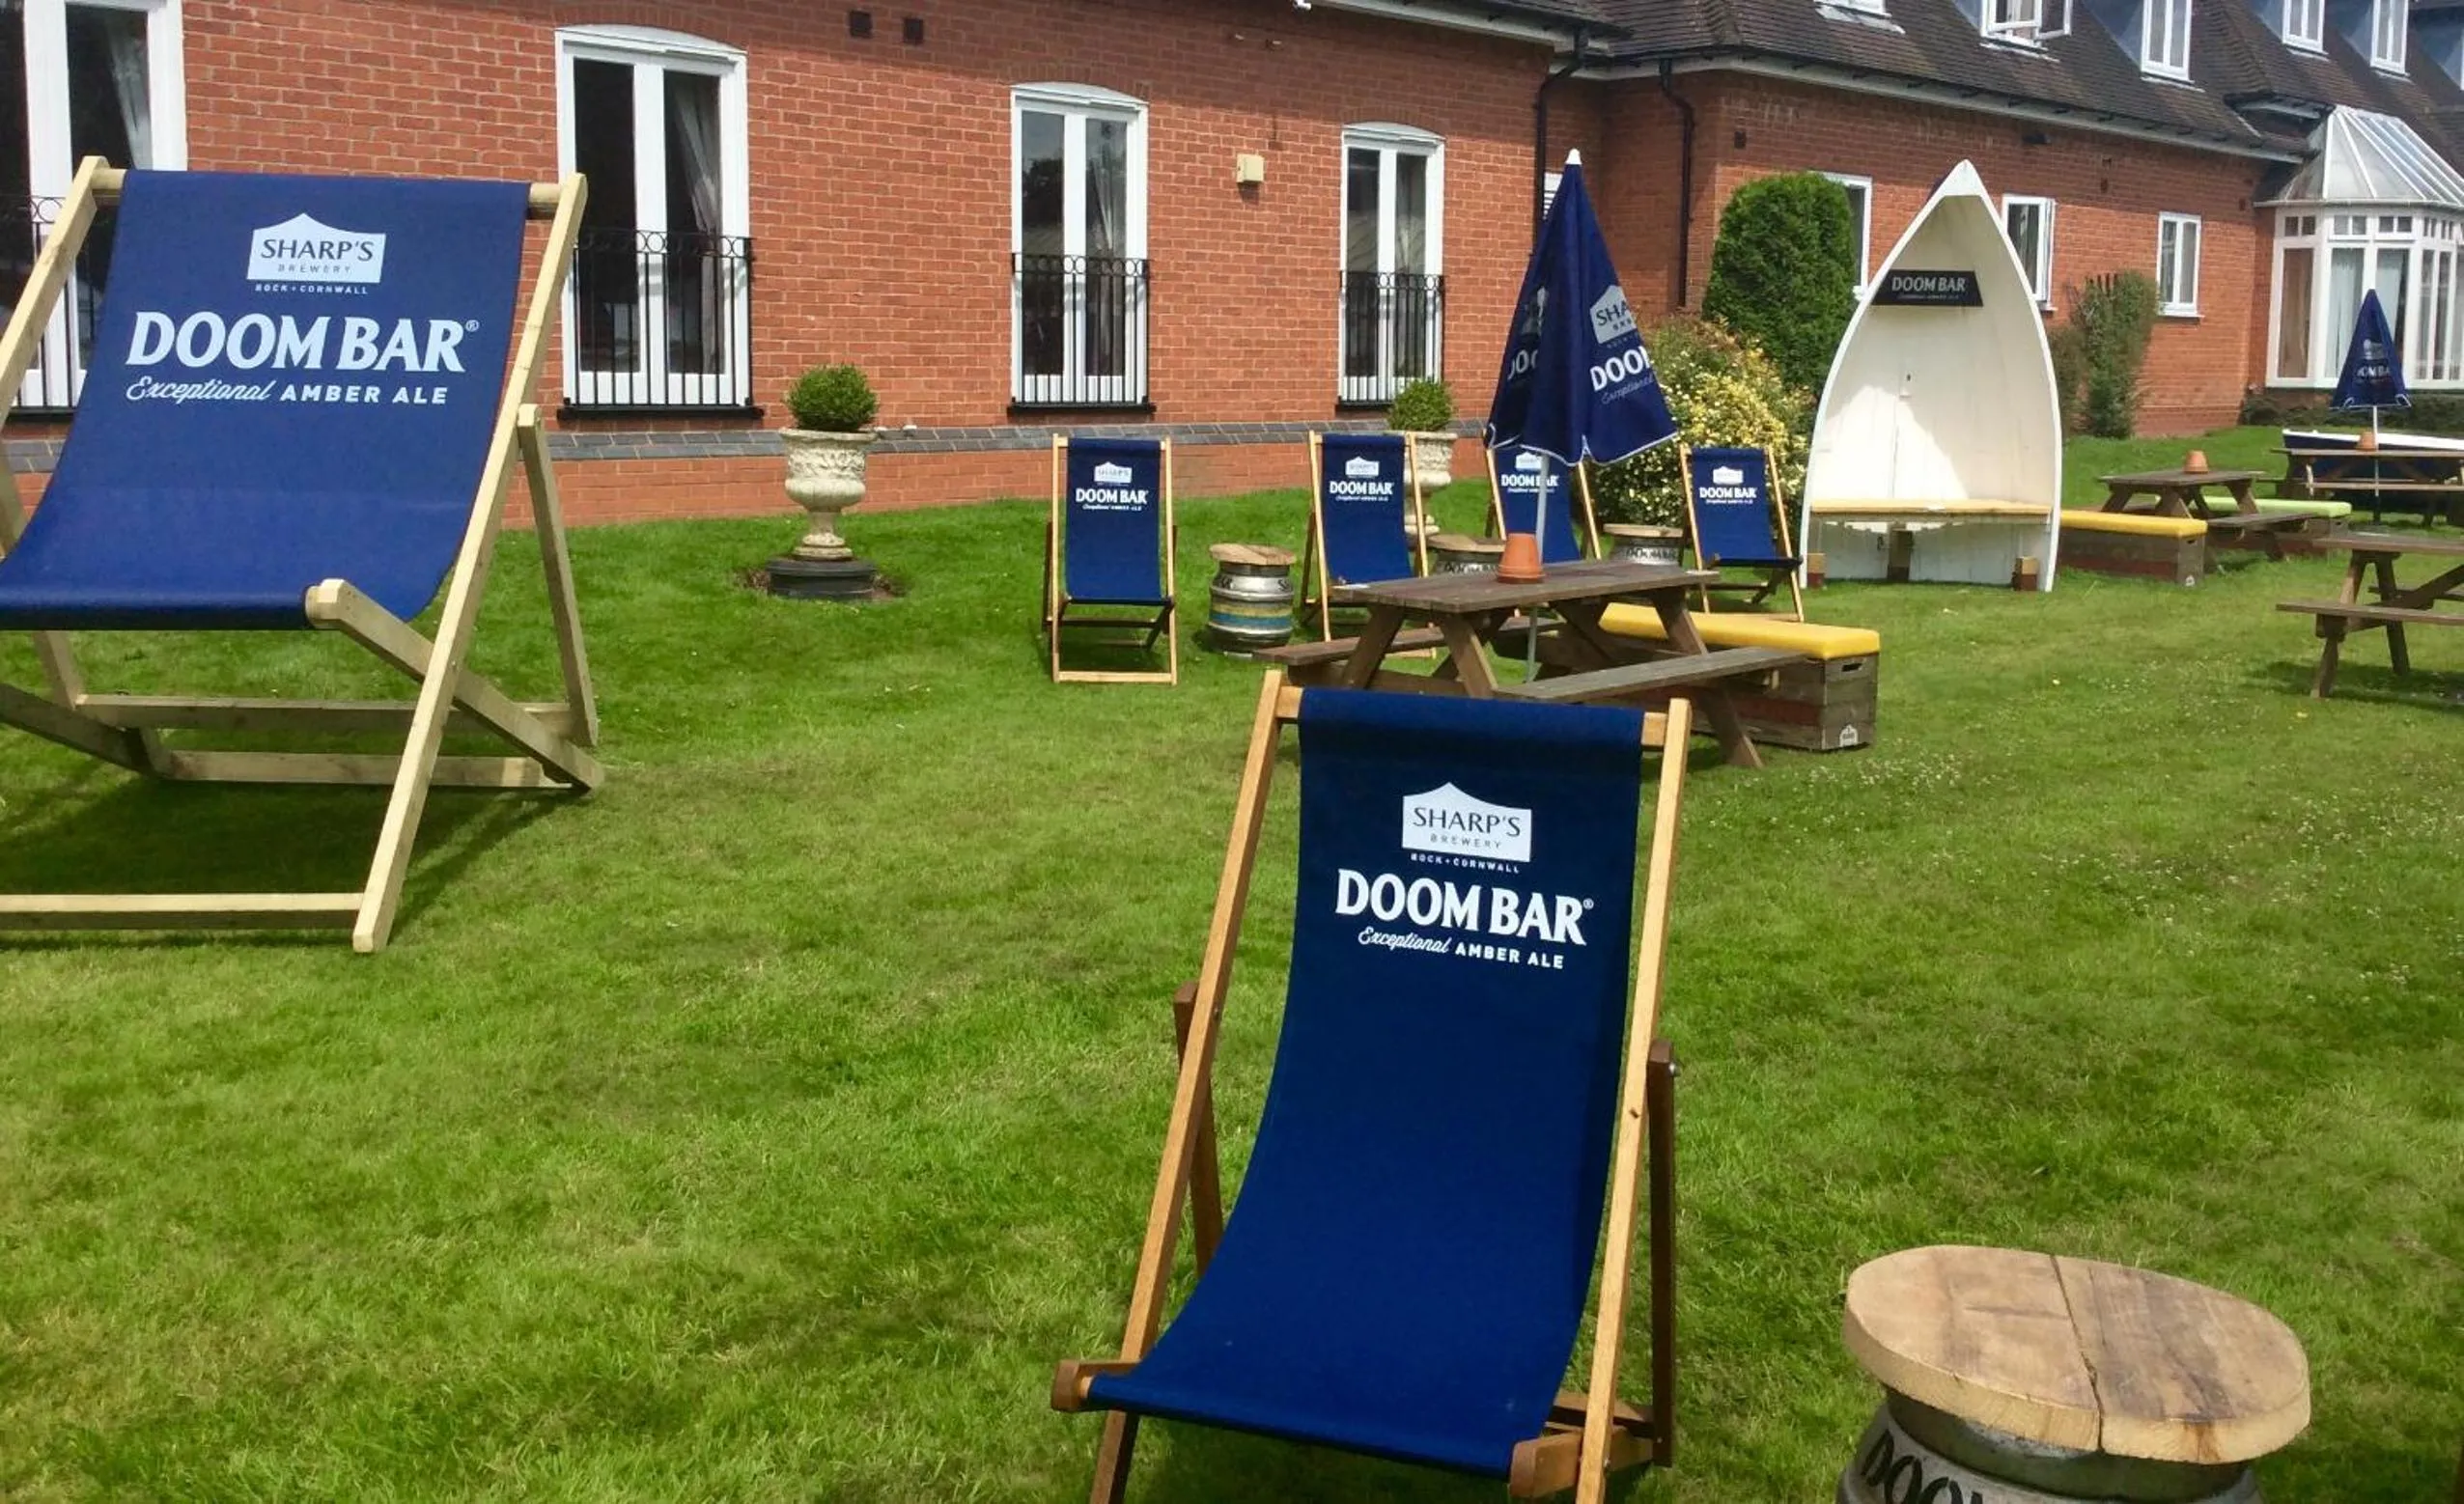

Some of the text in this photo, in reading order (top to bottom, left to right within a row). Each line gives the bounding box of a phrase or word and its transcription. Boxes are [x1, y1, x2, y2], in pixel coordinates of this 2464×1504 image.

[261, 238, 374, 262] SHARP'S
[277, 263, 351, 274] BREWERY
[254, 283, 369, 294] ROCK CORNWALL
[1891, 276, 1966, 292] DOOM BAR
[125, 311, 331, 370] DOOM
[126, 375, 448, 404] Exceptional AMBER ALE
[1075, 487, 1118, 503] DOOM
[1329, 481, 1367, 494] DOOM
[1698, 487, 1733, 498] DOOM
[1412, 806, 1522, 838] SHARP'S
[1429, 833, 1502, 849] BREWERY
[1410, 852, 1521, 874] ROCK CORNWALL
[1335, 868, 1482, 932] DOOM
[1358, 926, 1564, 970] Exceptional AMBER ALE
